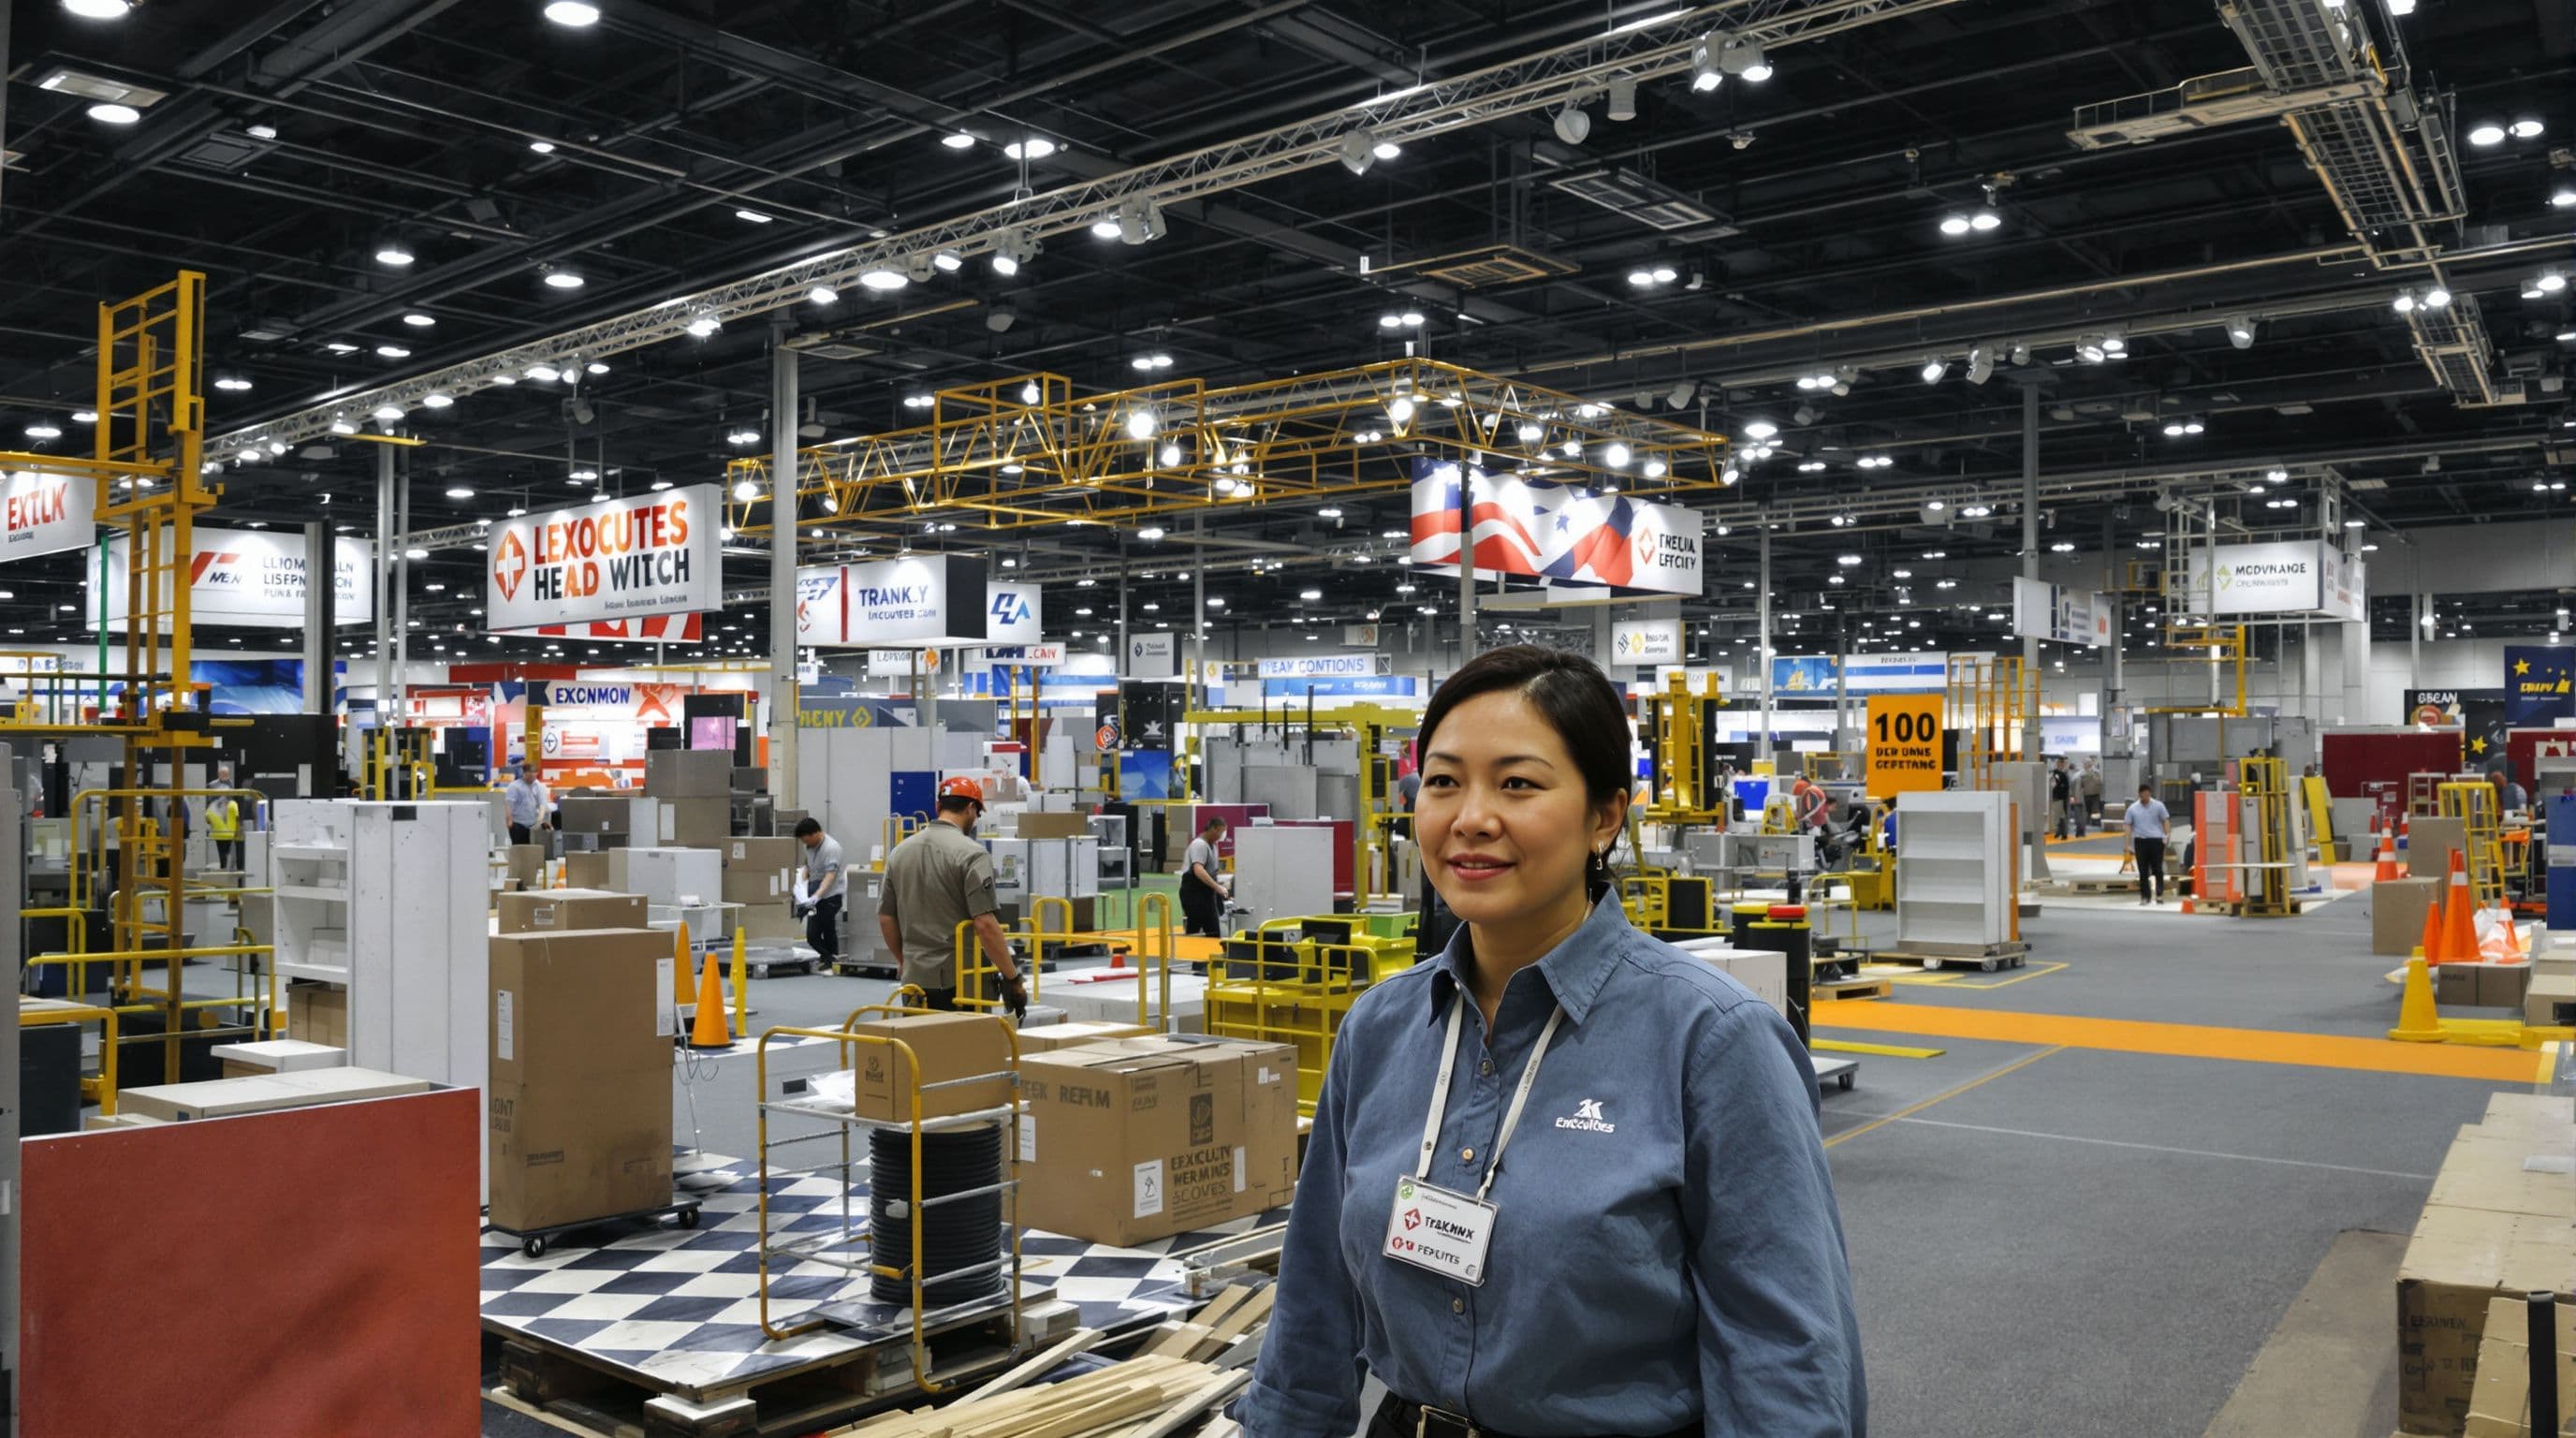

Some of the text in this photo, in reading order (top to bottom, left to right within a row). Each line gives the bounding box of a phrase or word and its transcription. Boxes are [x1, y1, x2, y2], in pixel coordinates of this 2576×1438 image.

[534, 502, 688, 565] LEXOCUTES
[534, 549, 690, 601] HEAD WITCH
[1875, 712, 1935, 742] 100
